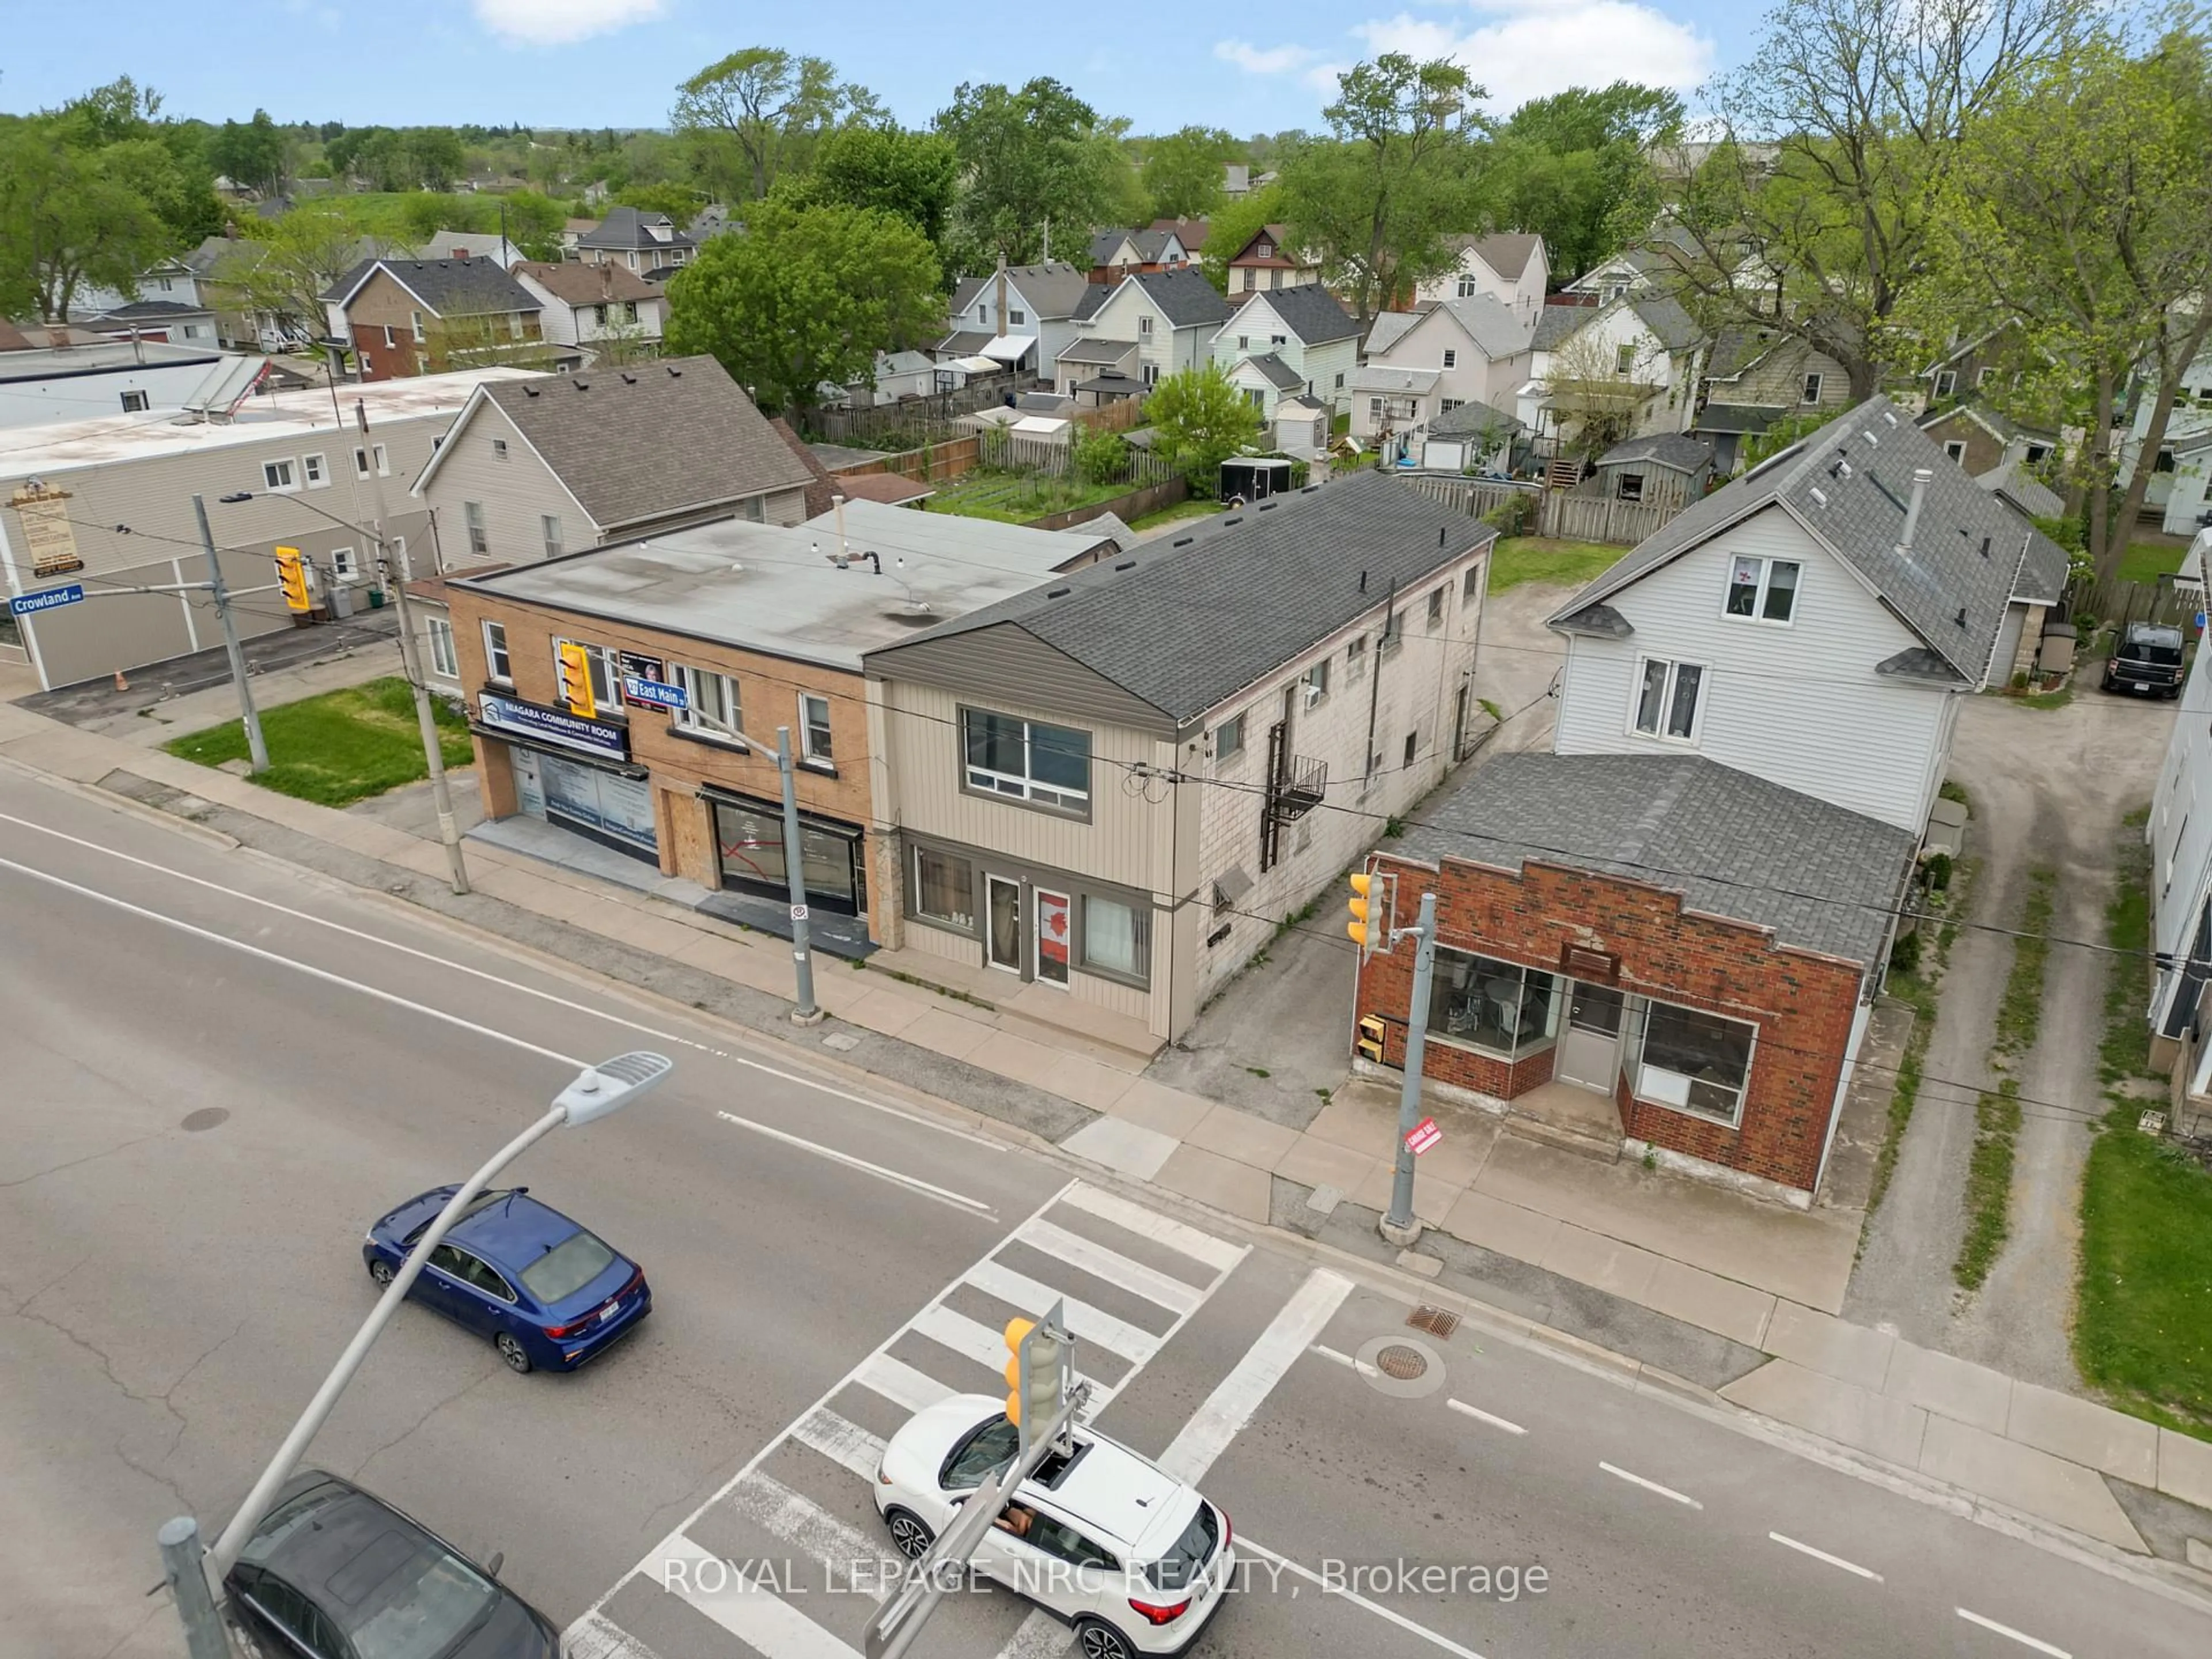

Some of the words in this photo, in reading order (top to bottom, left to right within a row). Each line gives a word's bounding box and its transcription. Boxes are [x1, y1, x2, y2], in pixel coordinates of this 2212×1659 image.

[15, 590, 69, 612] Crowland
[639, 683, 657, 699] East
[658, 687, 679, 704] Main
[505, 702, 540, 719] NIAGARA
[541, 711, 590, 733] COMMUNITY
[591, 725, 617, 740] ROOM
